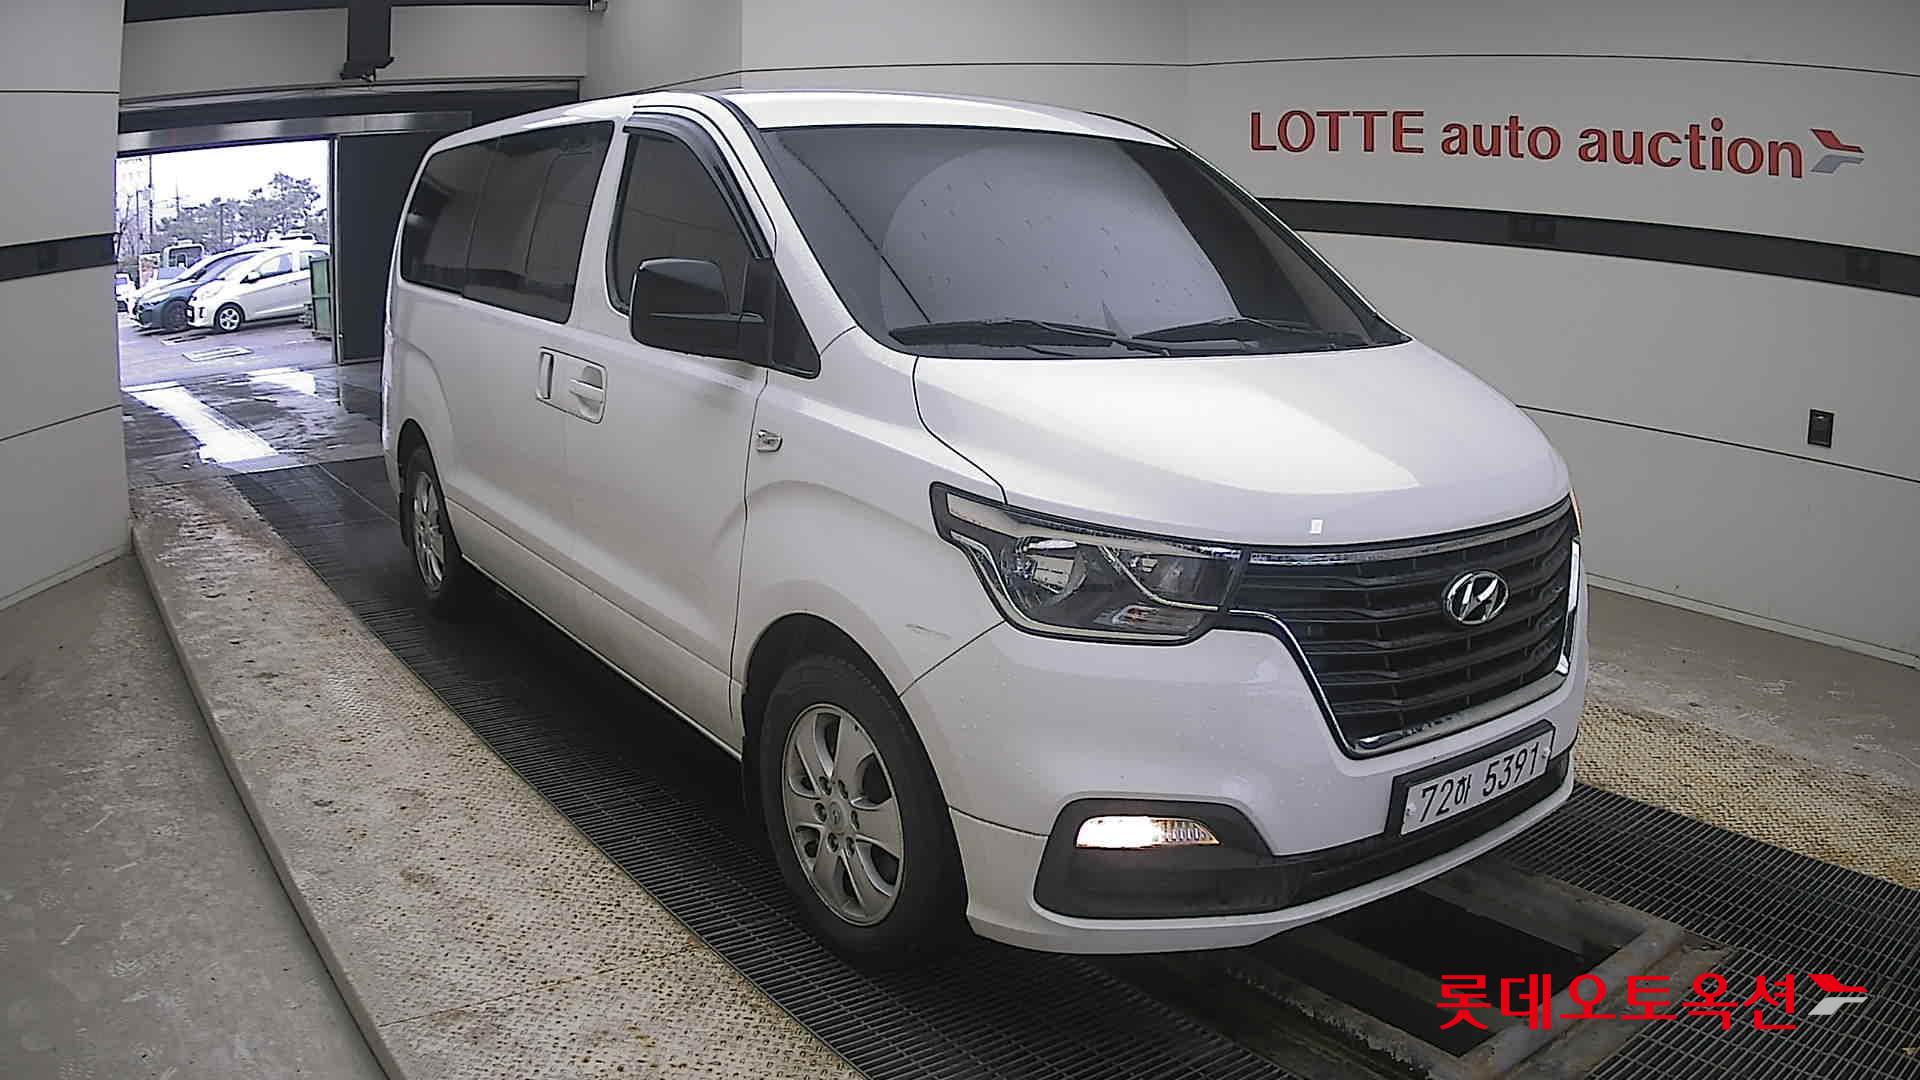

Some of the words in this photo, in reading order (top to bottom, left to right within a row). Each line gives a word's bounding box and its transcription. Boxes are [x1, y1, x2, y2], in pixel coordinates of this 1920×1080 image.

[1250, 110, 1424, 153] LOTTE
[1441, 115, 1561, 160] auto
[1578, 118, 1803, 178] auction
[1419, 774, 1473, 823] 72하
[1482, 741, 1540, 797] 5391
